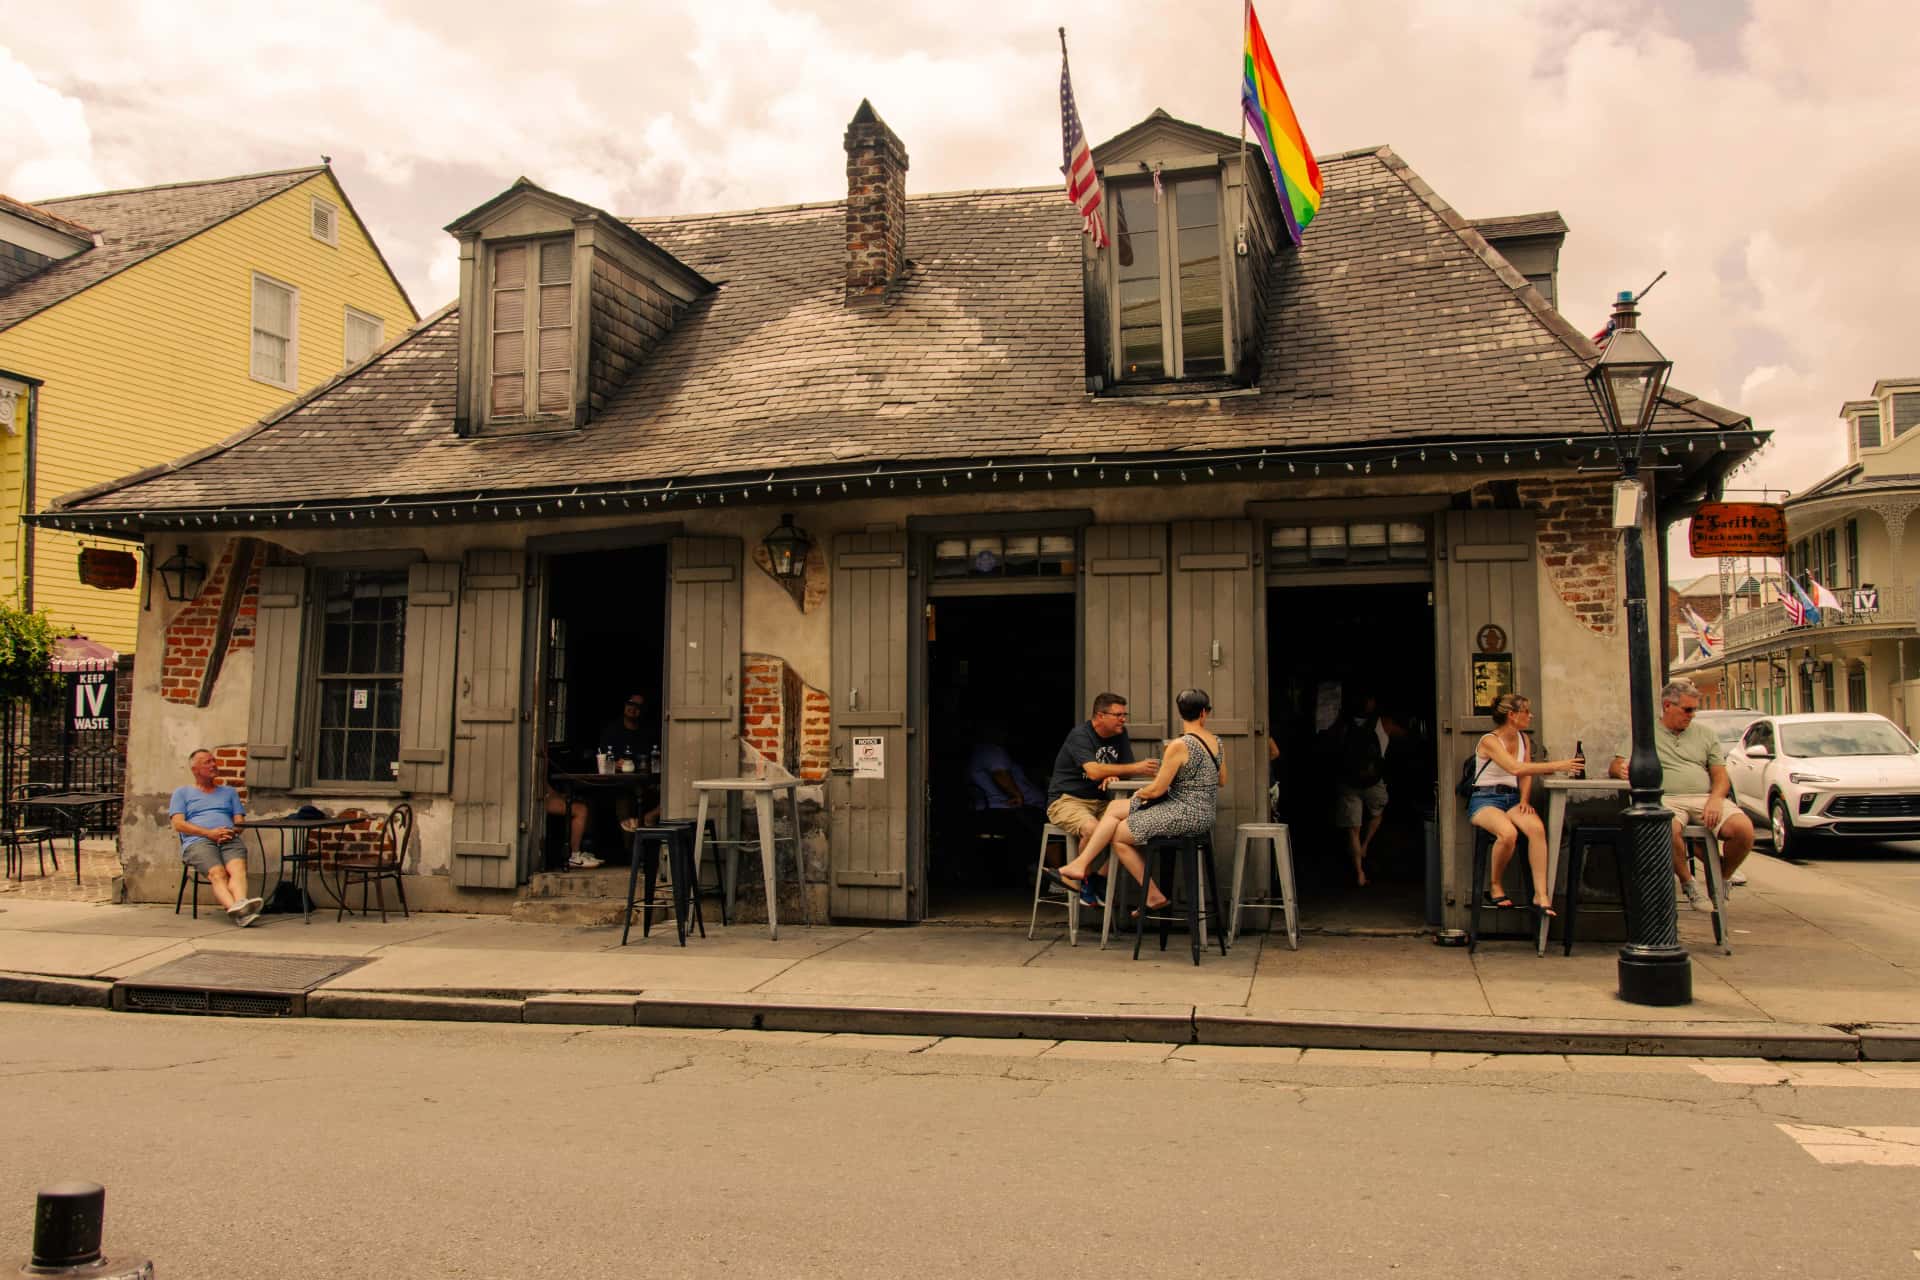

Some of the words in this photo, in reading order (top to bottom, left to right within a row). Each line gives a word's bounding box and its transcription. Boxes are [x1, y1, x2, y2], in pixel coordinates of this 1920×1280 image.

[1854, 594, 1876, 608] IV
[80, 674, 104, 683] KEEP
[76, 683, 108, 717] IV
[74, 717, 109, 730] WASTE
